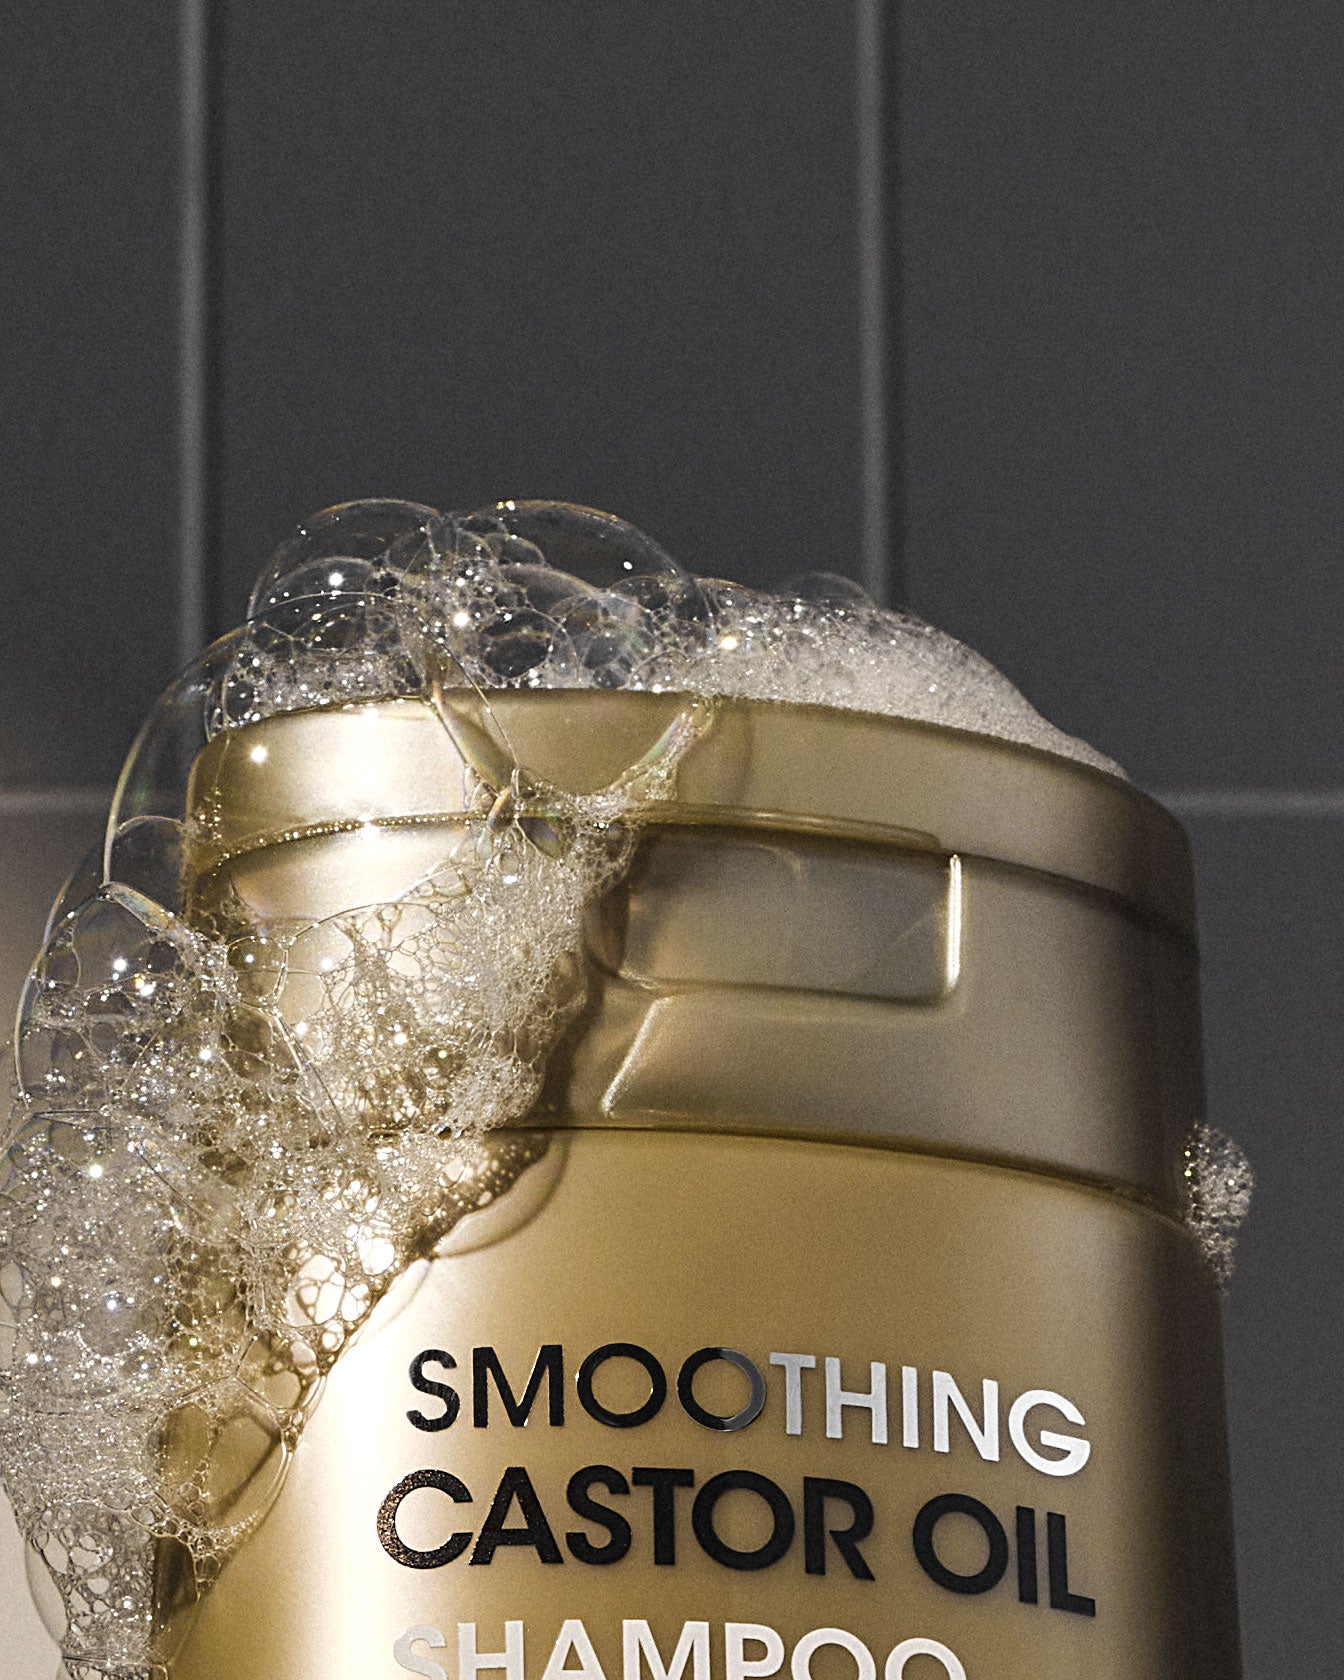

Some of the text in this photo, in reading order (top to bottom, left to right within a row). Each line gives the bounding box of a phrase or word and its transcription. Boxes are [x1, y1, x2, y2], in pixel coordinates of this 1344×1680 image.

[407, 1343, 1091, 1476] SMOOTHING
[376, 1464, 1096, 1617] CASTOR OIL
